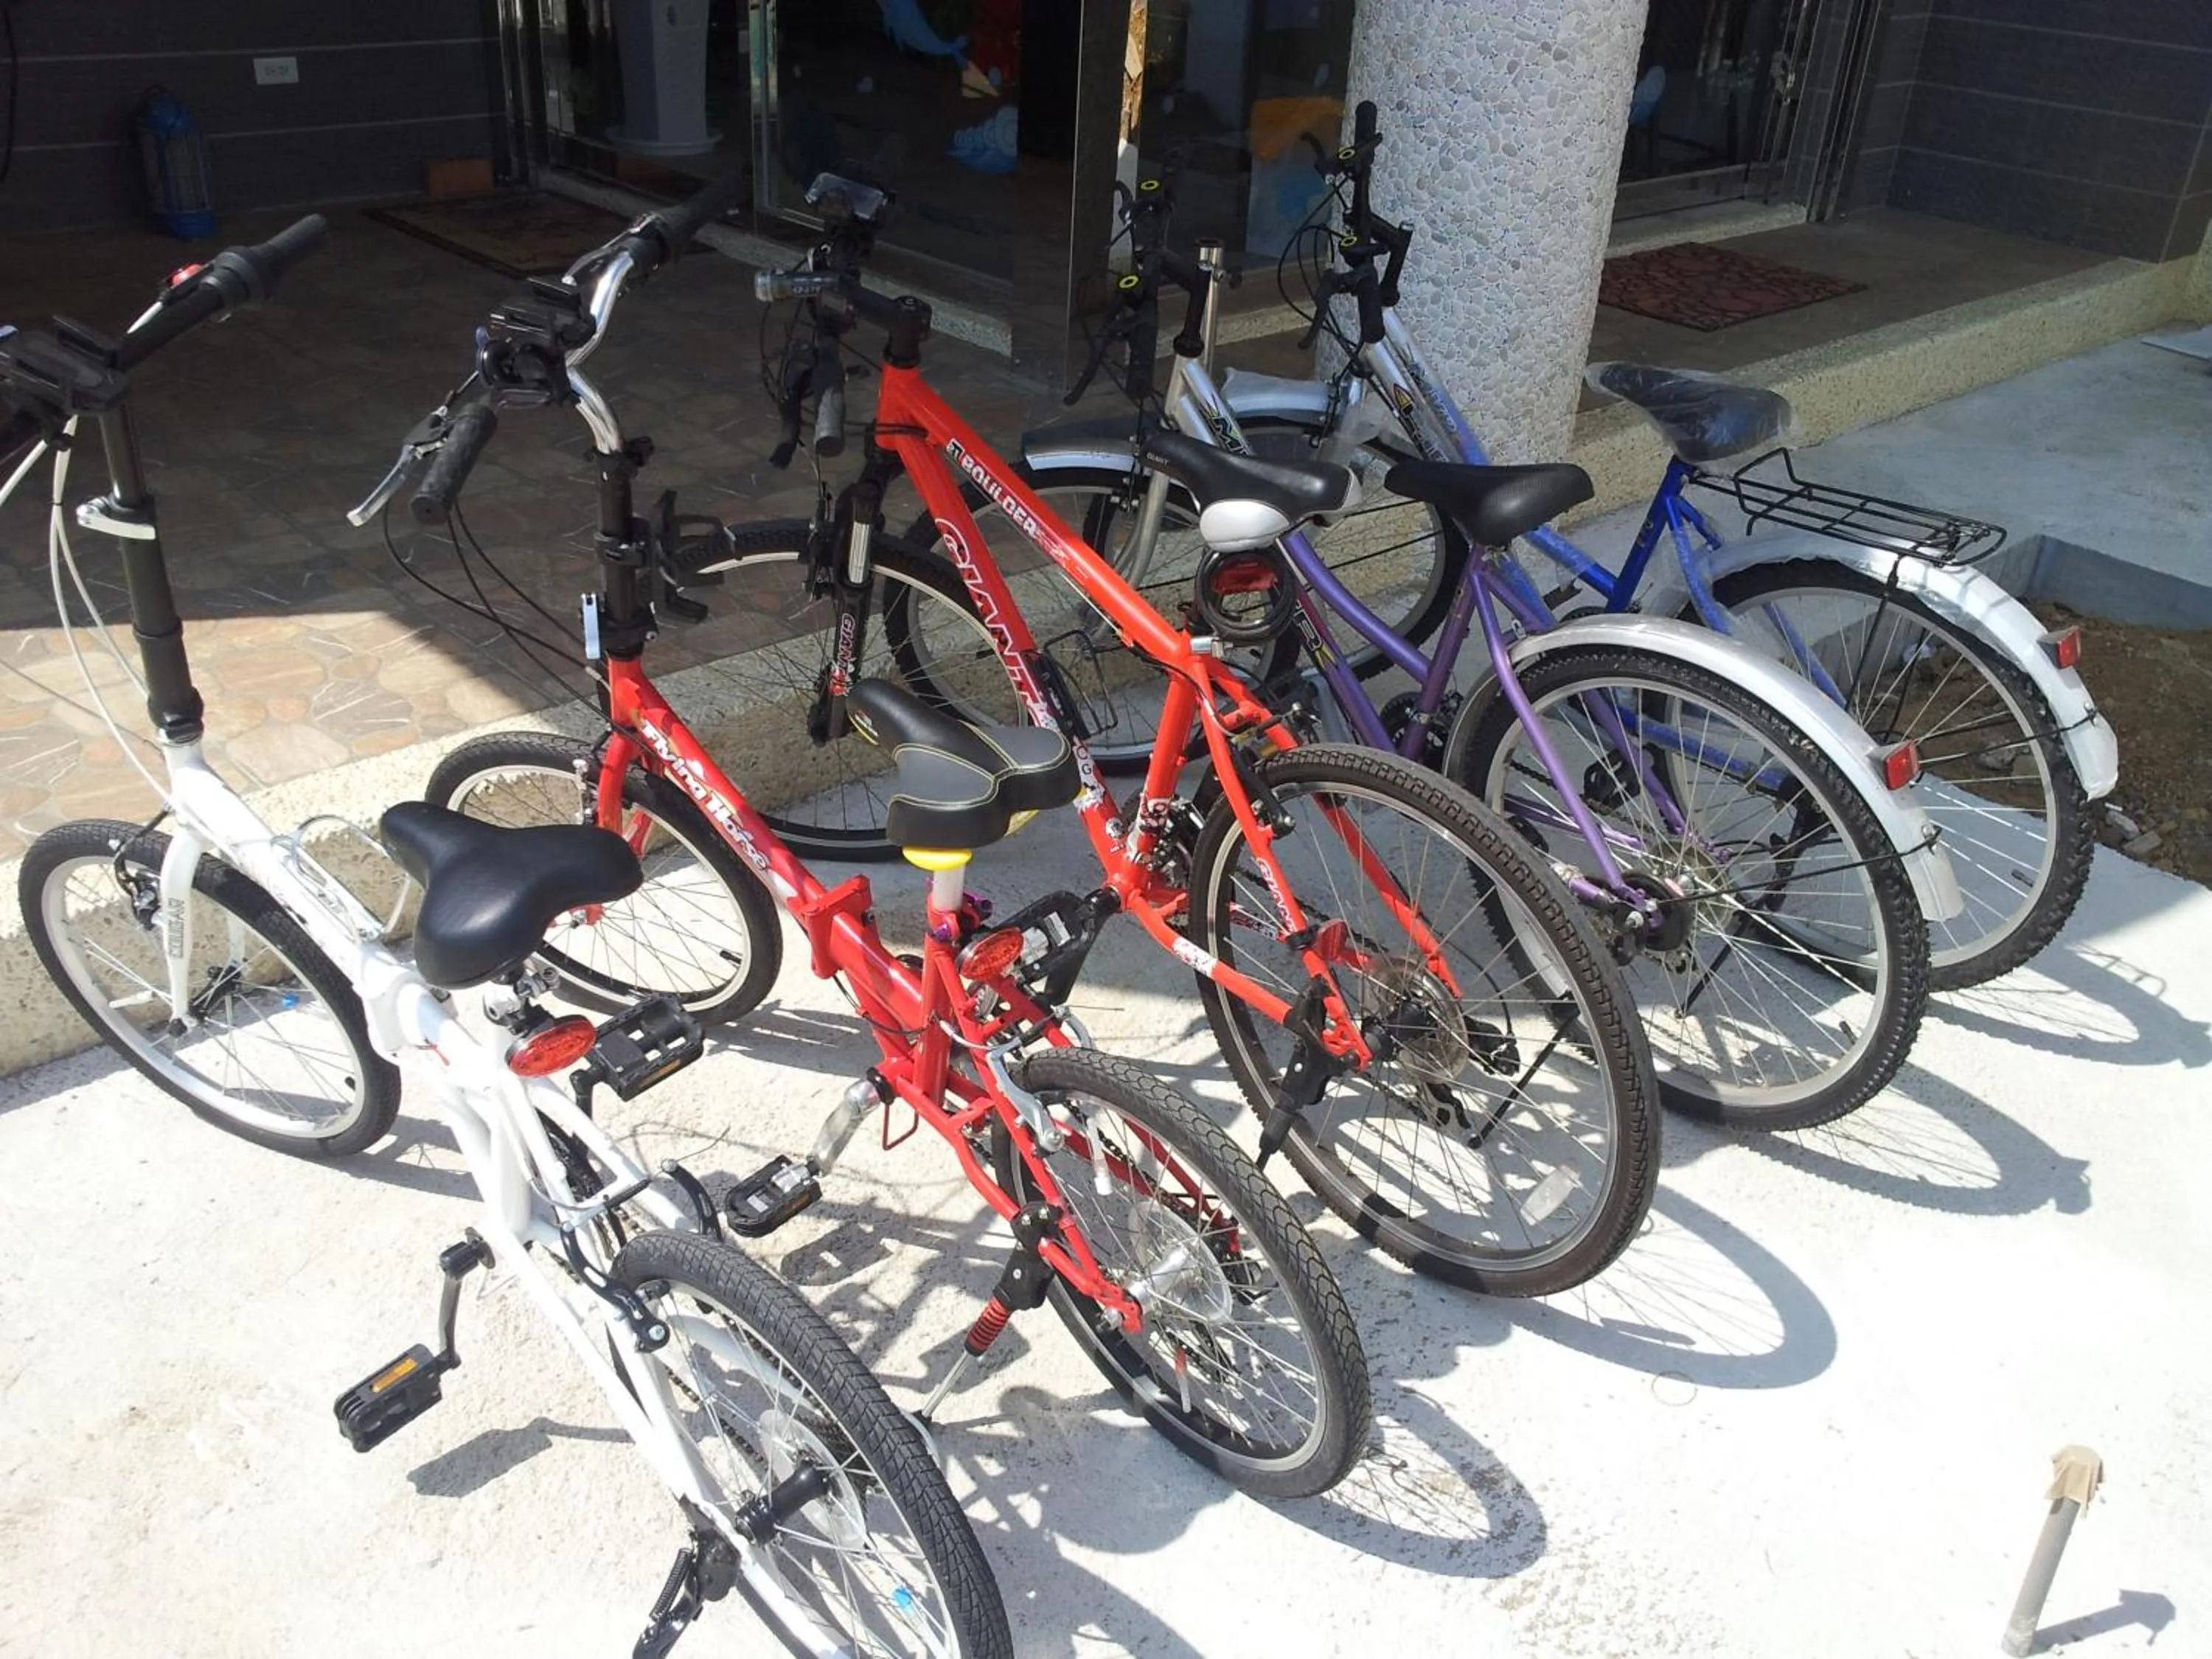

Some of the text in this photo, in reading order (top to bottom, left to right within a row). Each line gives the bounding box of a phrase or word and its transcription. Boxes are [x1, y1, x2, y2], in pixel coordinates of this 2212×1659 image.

[961, 453, 1039, 540] BOULDER
[934, 518, 1042, 705] GIANT
[641, 719, 771, 870] Flying Horse
